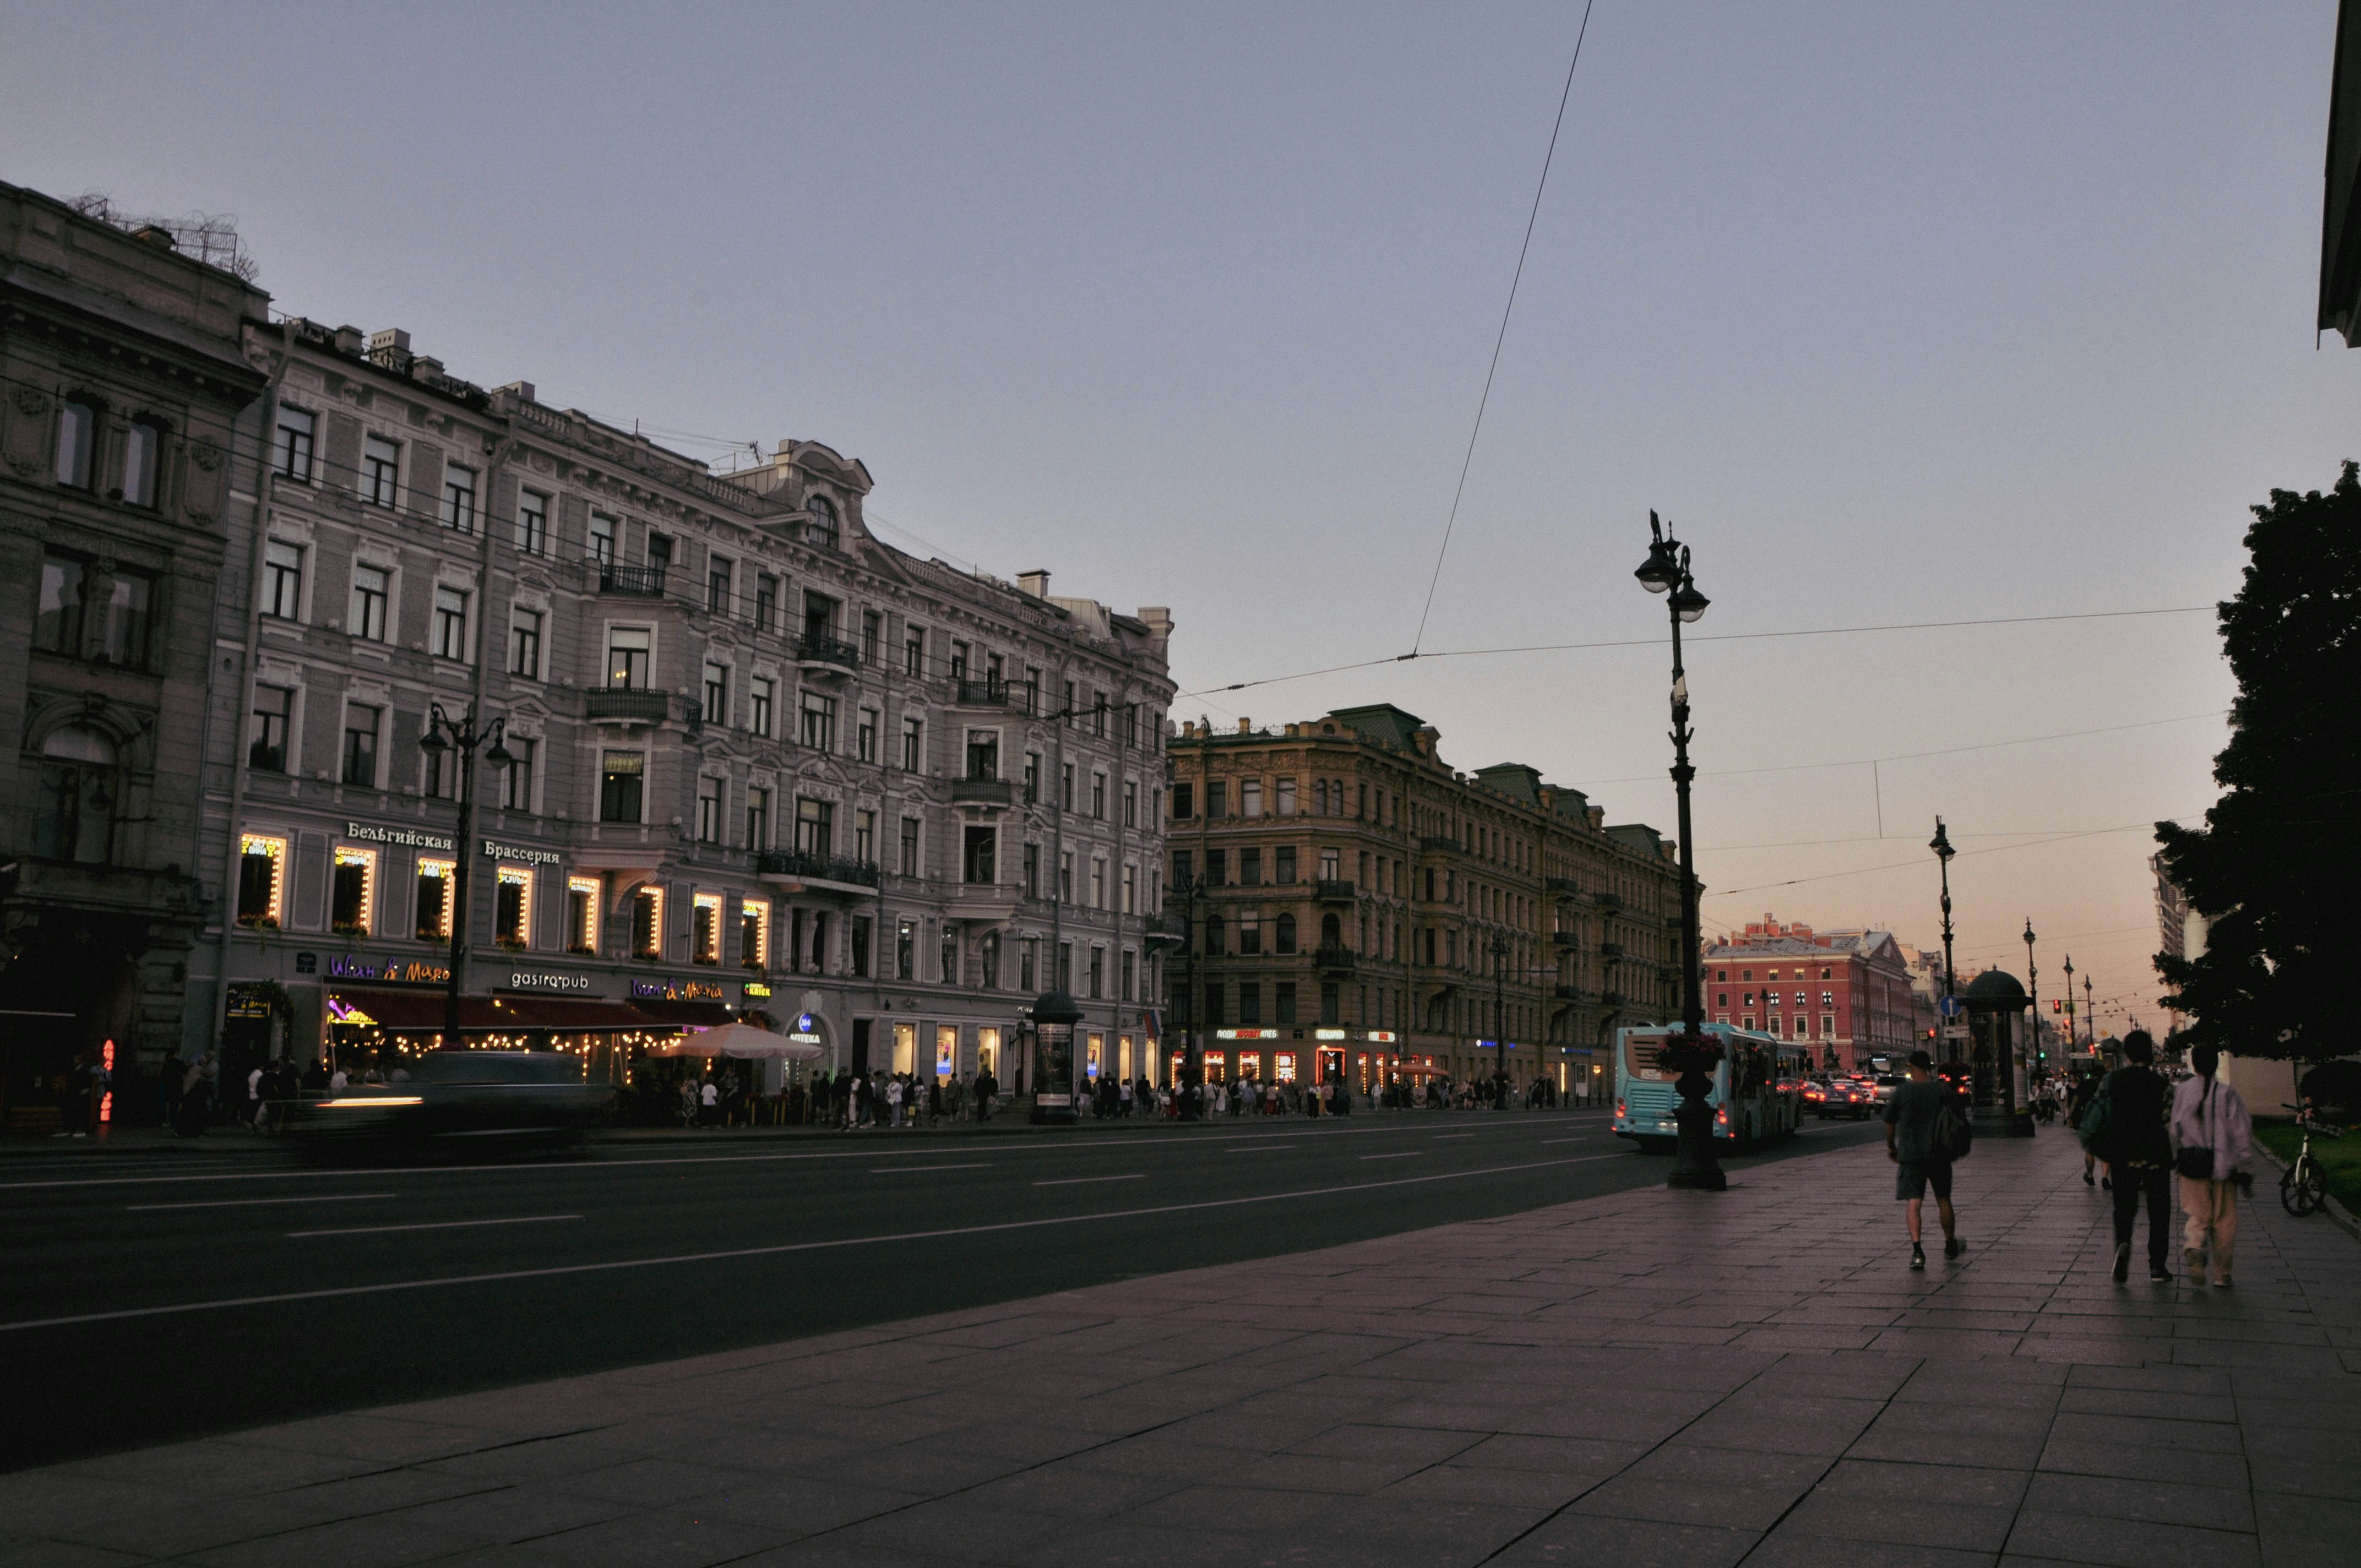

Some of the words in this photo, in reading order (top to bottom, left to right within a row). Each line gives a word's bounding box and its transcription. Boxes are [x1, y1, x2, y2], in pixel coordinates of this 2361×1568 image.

[348, 822, 452, 850] Бельгийская
[485, 841, 560, 864] Брассерия
[405, 961, 451, 982] Марь
[633, 979, 660, 996] Ivan
[684, 982, 723, 1000] Maria
[790, 1033, 820, 1044] АПТЕКА
